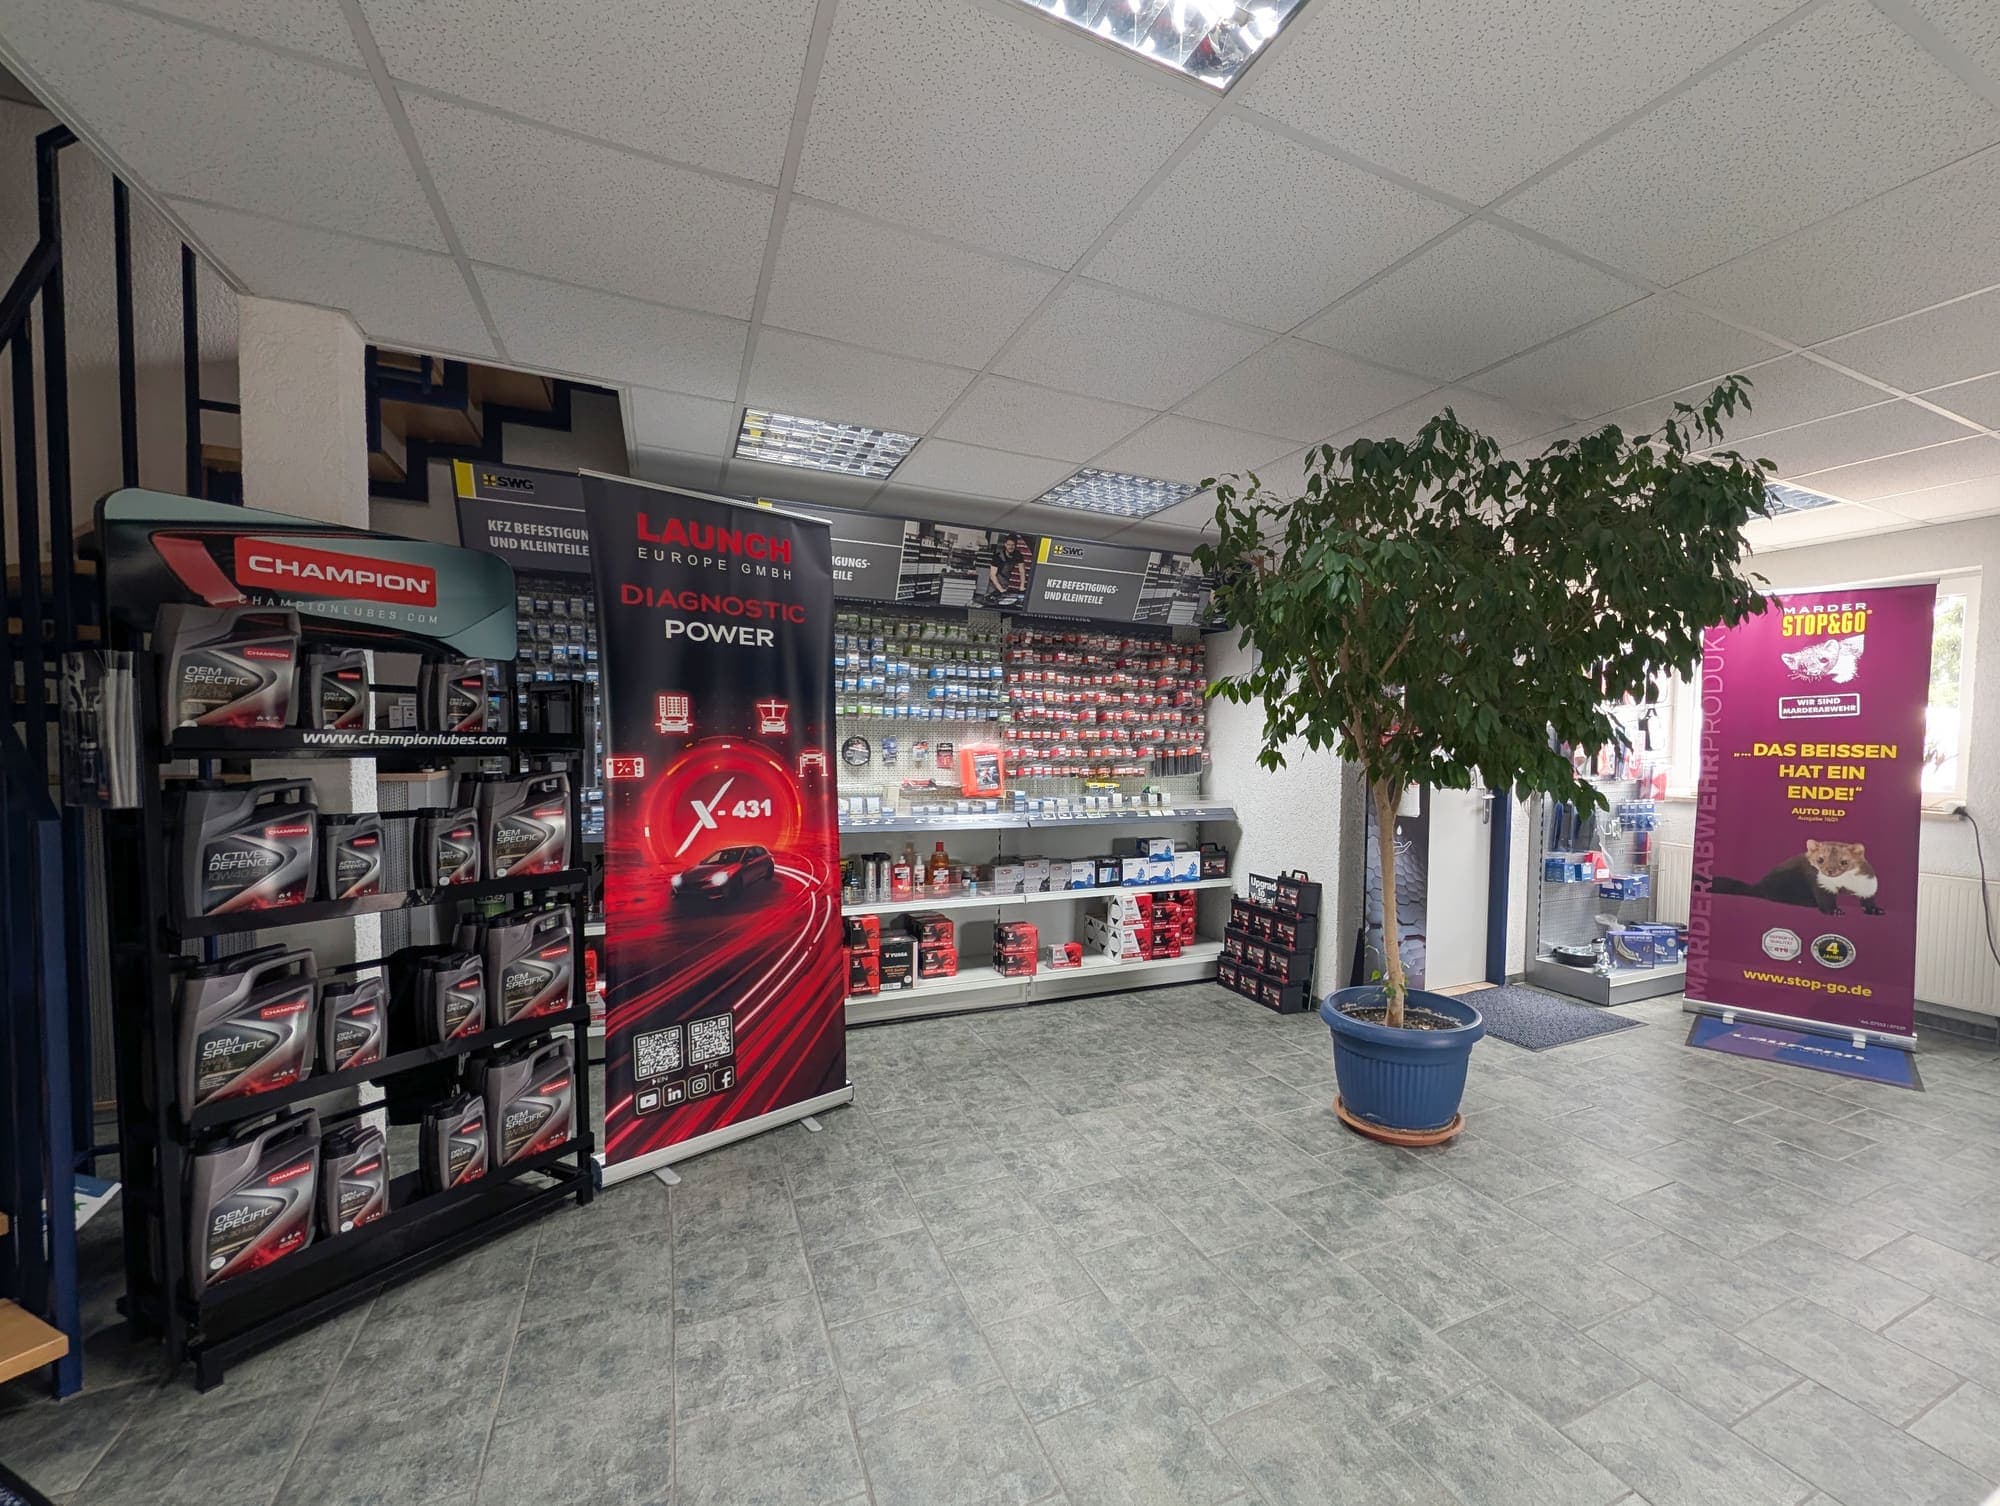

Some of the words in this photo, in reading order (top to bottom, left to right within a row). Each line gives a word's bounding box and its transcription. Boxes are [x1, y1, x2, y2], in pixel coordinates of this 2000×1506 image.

[498, 476, 534, 490] SWG
[488, 519, 512, 533] KFZ
[514, 523, 589, 541] BEFESTIGUN
[637, 512, 792, 564] LAUNCH
[489, 536, 518, 549] UND
[521, 539, 589, 556] KLEINTEILE
[1062, 546, 1084, 557] SWG
[638, 547, 728, 571] EUROPE
[741, 563, 792, 581] GMBH
[832, 555, 871, 569] IGUNGS-
[249, 555, 429, 594] CHAMPION
[833, 572, 854, 581] EILE
[1047, 578, 1061, 588] KFZ
[1062, 581, 1119, 594] BEFESTIGUNGS-
[620, 583, 806, 624] DIAGNOSTIC
[1044, 591, 1062, 601] UND
[1062, 592, 1104, 605] KLEINTEILE
[1784, 602, 1867, 614] MARDER
[1782, 610, 1867, 637] STOP&GO
[665, 619, 775, 648] POWER
[185, 665, 222, 675] OEM
[184, 675, 249, 686] SPECIFIC
[1797, 698, 1815, 706] WIR
[1817, 697, 1841, 705] SIND
[1782, 705, 1857, 714] MARDERABWEHR
[303, 732, 507, 747] www.championlubes.com
[1800, 743, 1897, 759] BEISSEN
[1779, 764, 1823, 778] HAT
[1827, 765, 1866, 780] EIN
[1791, 807, 1820, 816] AUTO
[1821, 808, 1846, 817] BILD
[496, 834, 537, 844] SPECIFIC
[497, 828, 521, 837] OEM
[211, 850, 262, 862] ACTIVE
[209, 858, 273, 871] DEFENCE
[1251, 876, 1277, 891] Upgrad
[1825, 942, 1840, 955] 4
[505, 975, 545, 990] SPECIFIC
[507, 972, 529, 983] OEM
[1743, 969, 1873, 997] www.stop-go.de
[202, 1039, 265, 1060] SPECIFIC
[205, 1036, 240, 1051] OEM
[505, 1111, 545, 1131] SPECIFIC
[507, 1109, 529, 1122] OEM
[212, 1205, 273, 1235] SPECIFIC
[215, 1206, 249, 1225] OEM
